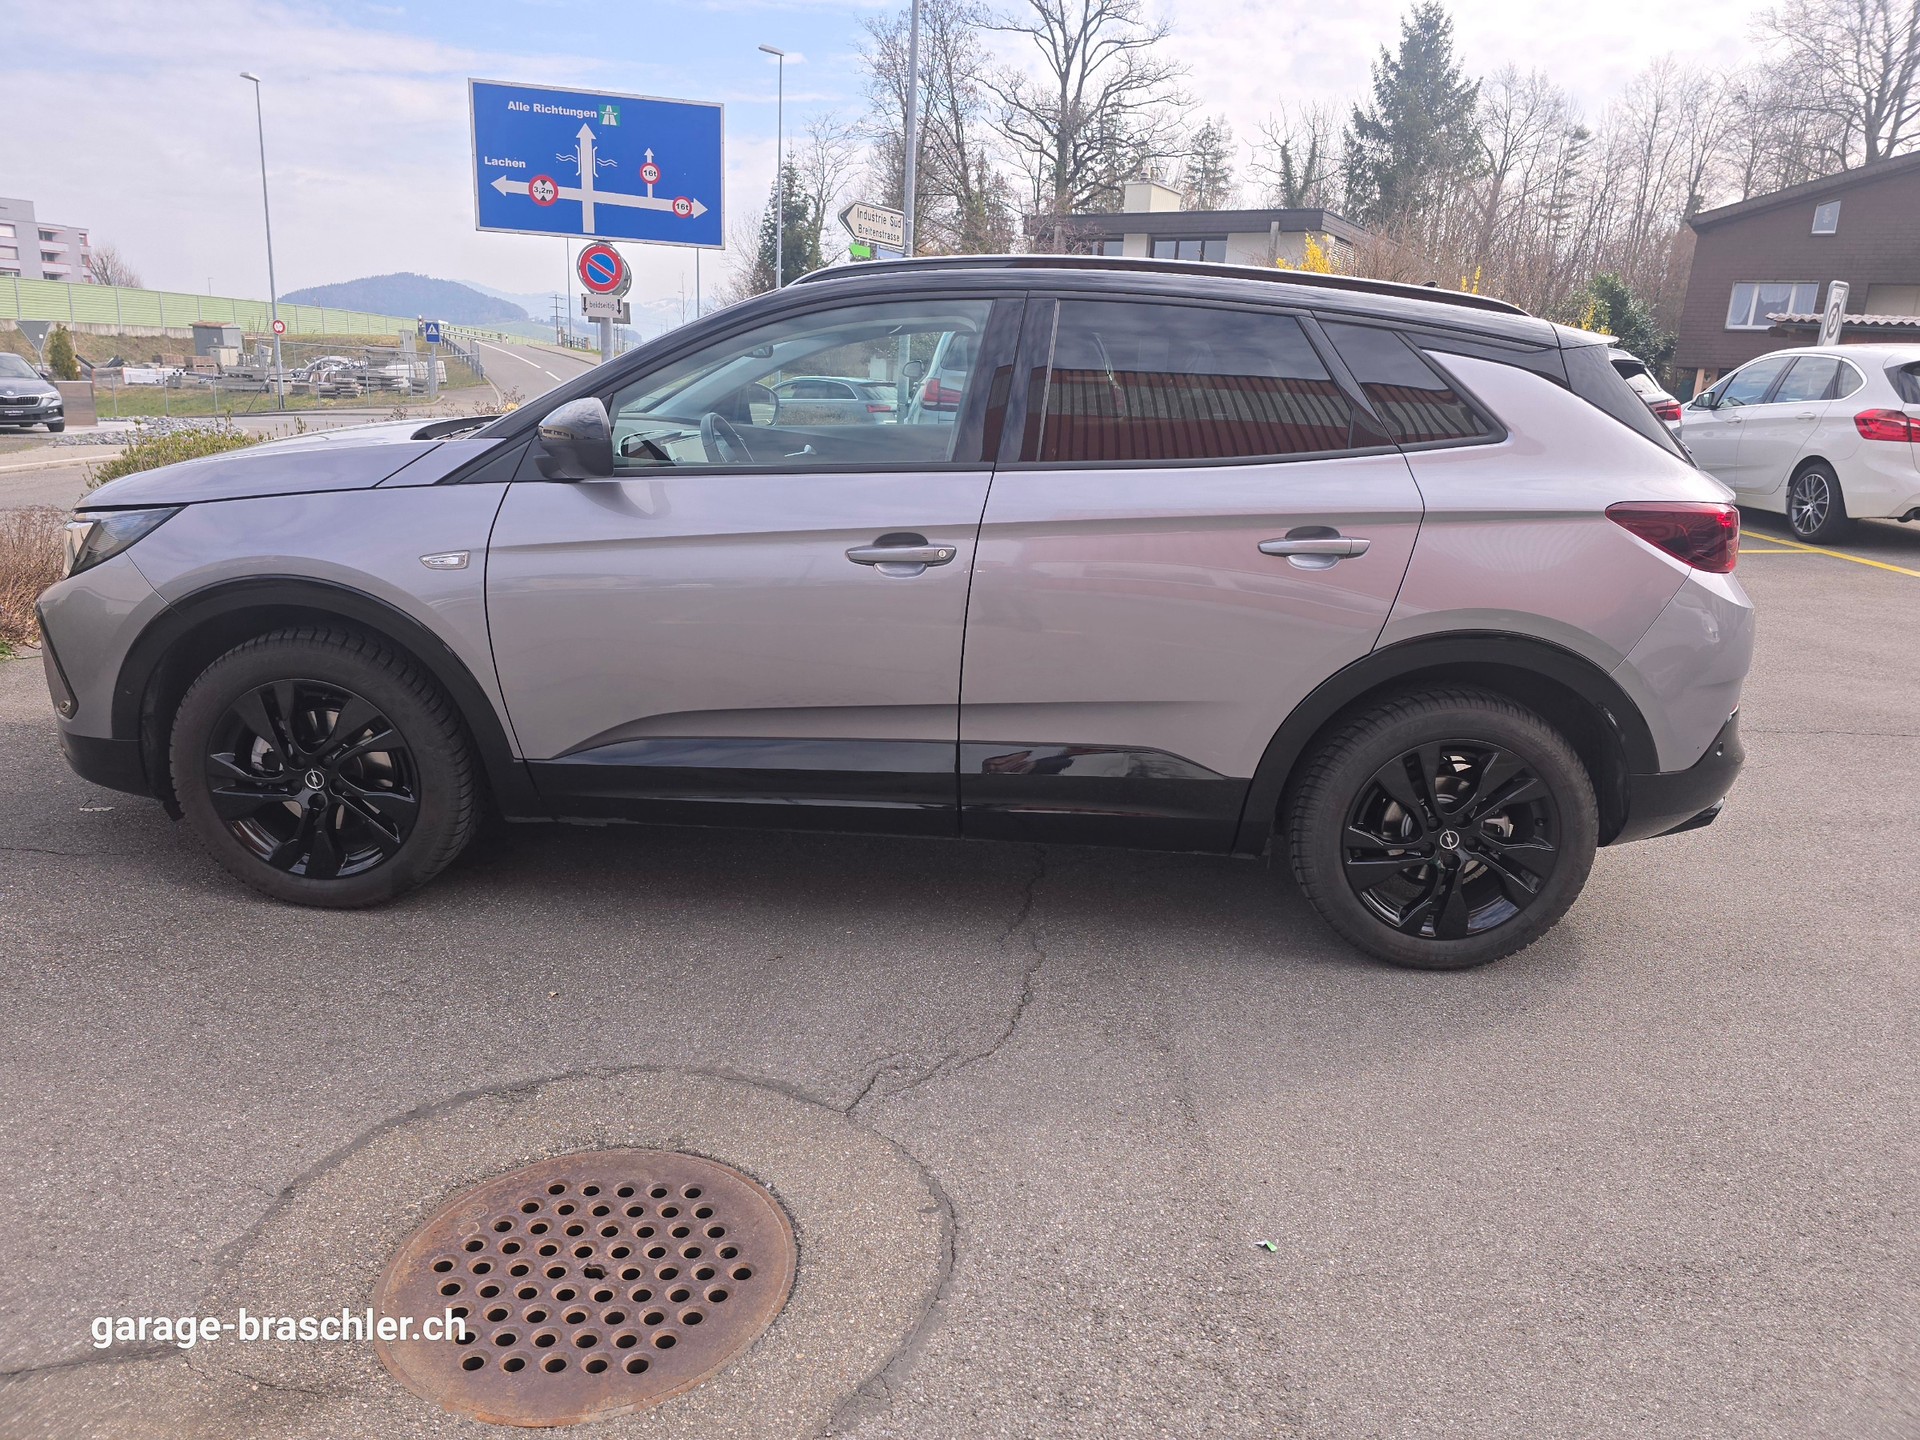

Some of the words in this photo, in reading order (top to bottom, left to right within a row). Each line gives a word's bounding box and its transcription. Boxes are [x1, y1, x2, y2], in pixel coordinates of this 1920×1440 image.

[507, 100, 531, 112] Alle
[533, 103, 598, 119] Richtungen
[484, 156, 526, 168] Lachen
[643, 169, 657, 178] 16t
[533, 186, 554, 195] 3,2m
[676, 203, 689, 212] 16t
[857, 207, 887, 225] Industrie
[889, 216, 902, 228] Süd
[858, 224, 900, 242] Breitenstrasse
